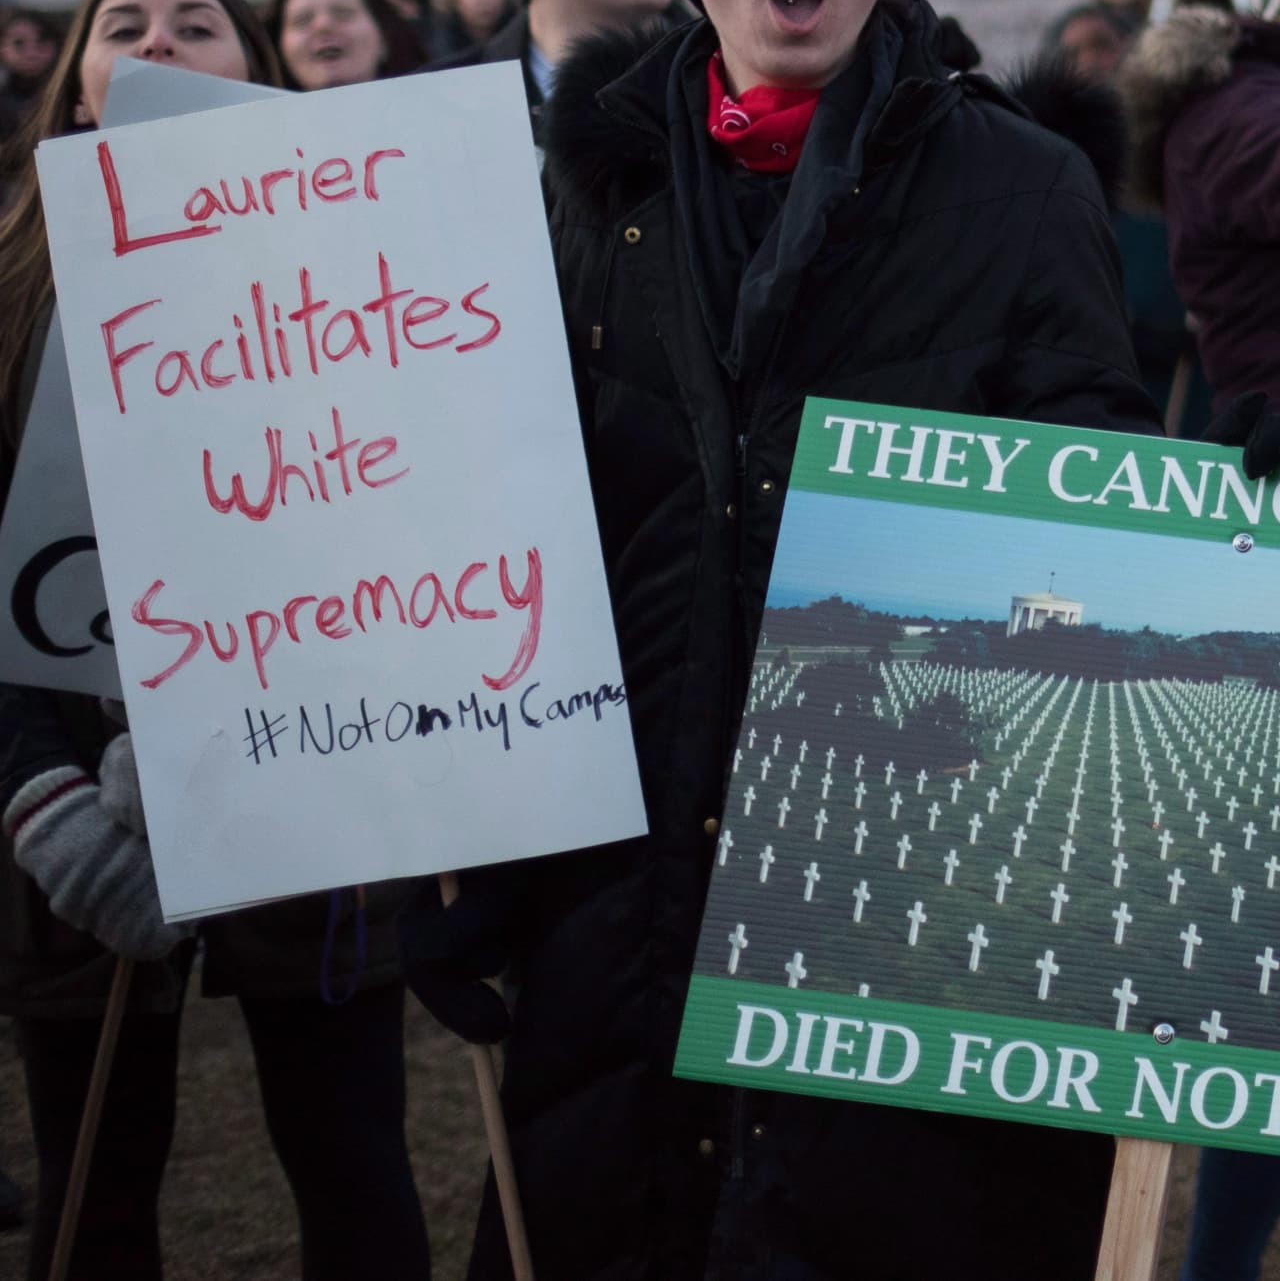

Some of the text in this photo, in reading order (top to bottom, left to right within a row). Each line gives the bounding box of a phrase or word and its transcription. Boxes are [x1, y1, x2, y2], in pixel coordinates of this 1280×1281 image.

[98, 141, 404, 256] Laurier
[101, 252, 502, 413] Facilitates
[204, 406, 410, 520] White
[824, 415, 1030, 492] THEY
[131, 547, 543, 690] Supremacy
[727, 1004, 920, 1085] DIED
[940, 1031, 1101, 1112] FOR
